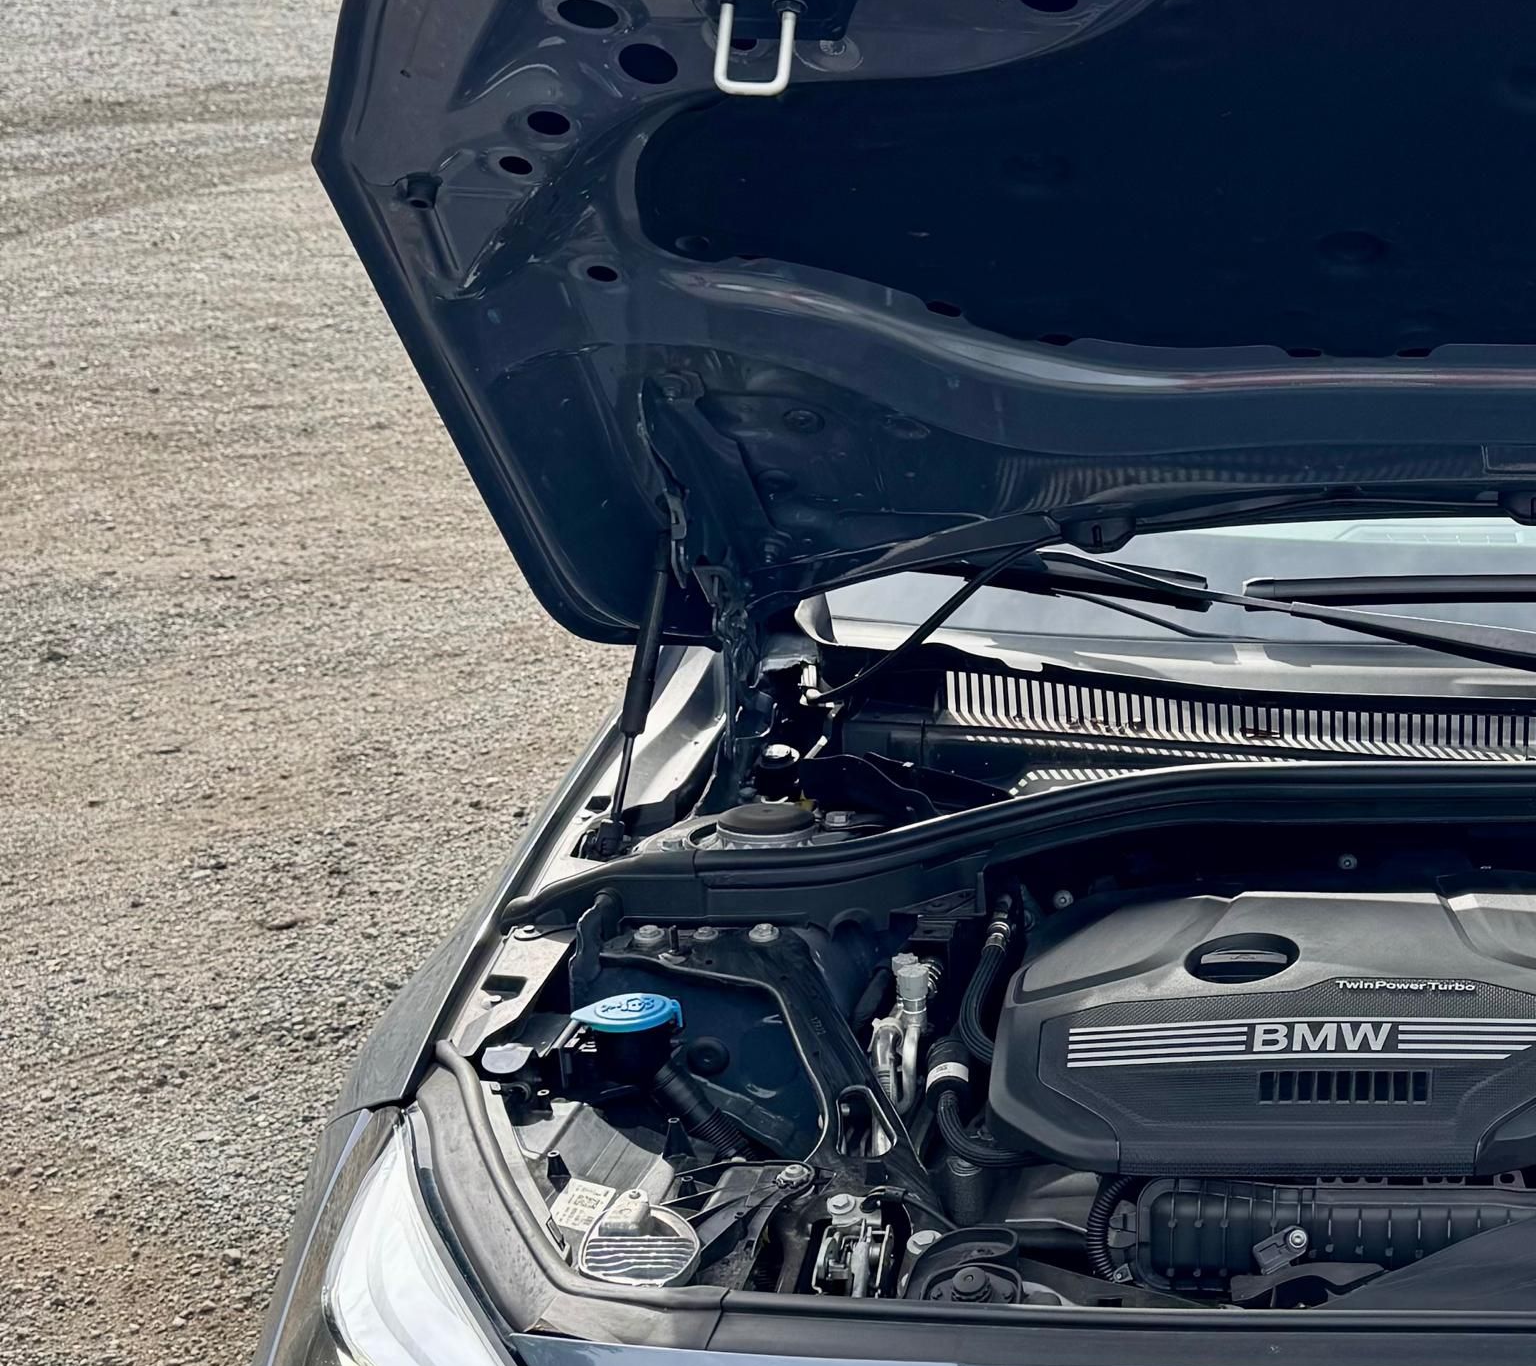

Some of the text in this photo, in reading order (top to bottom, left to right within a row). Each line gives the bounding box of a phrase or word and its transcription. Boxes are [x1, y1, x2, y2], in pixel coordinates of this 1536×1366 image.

[1335, 979, 1477, 992] TwinPower Turbo
[1252, 1022, 1392, 1053] BMW
